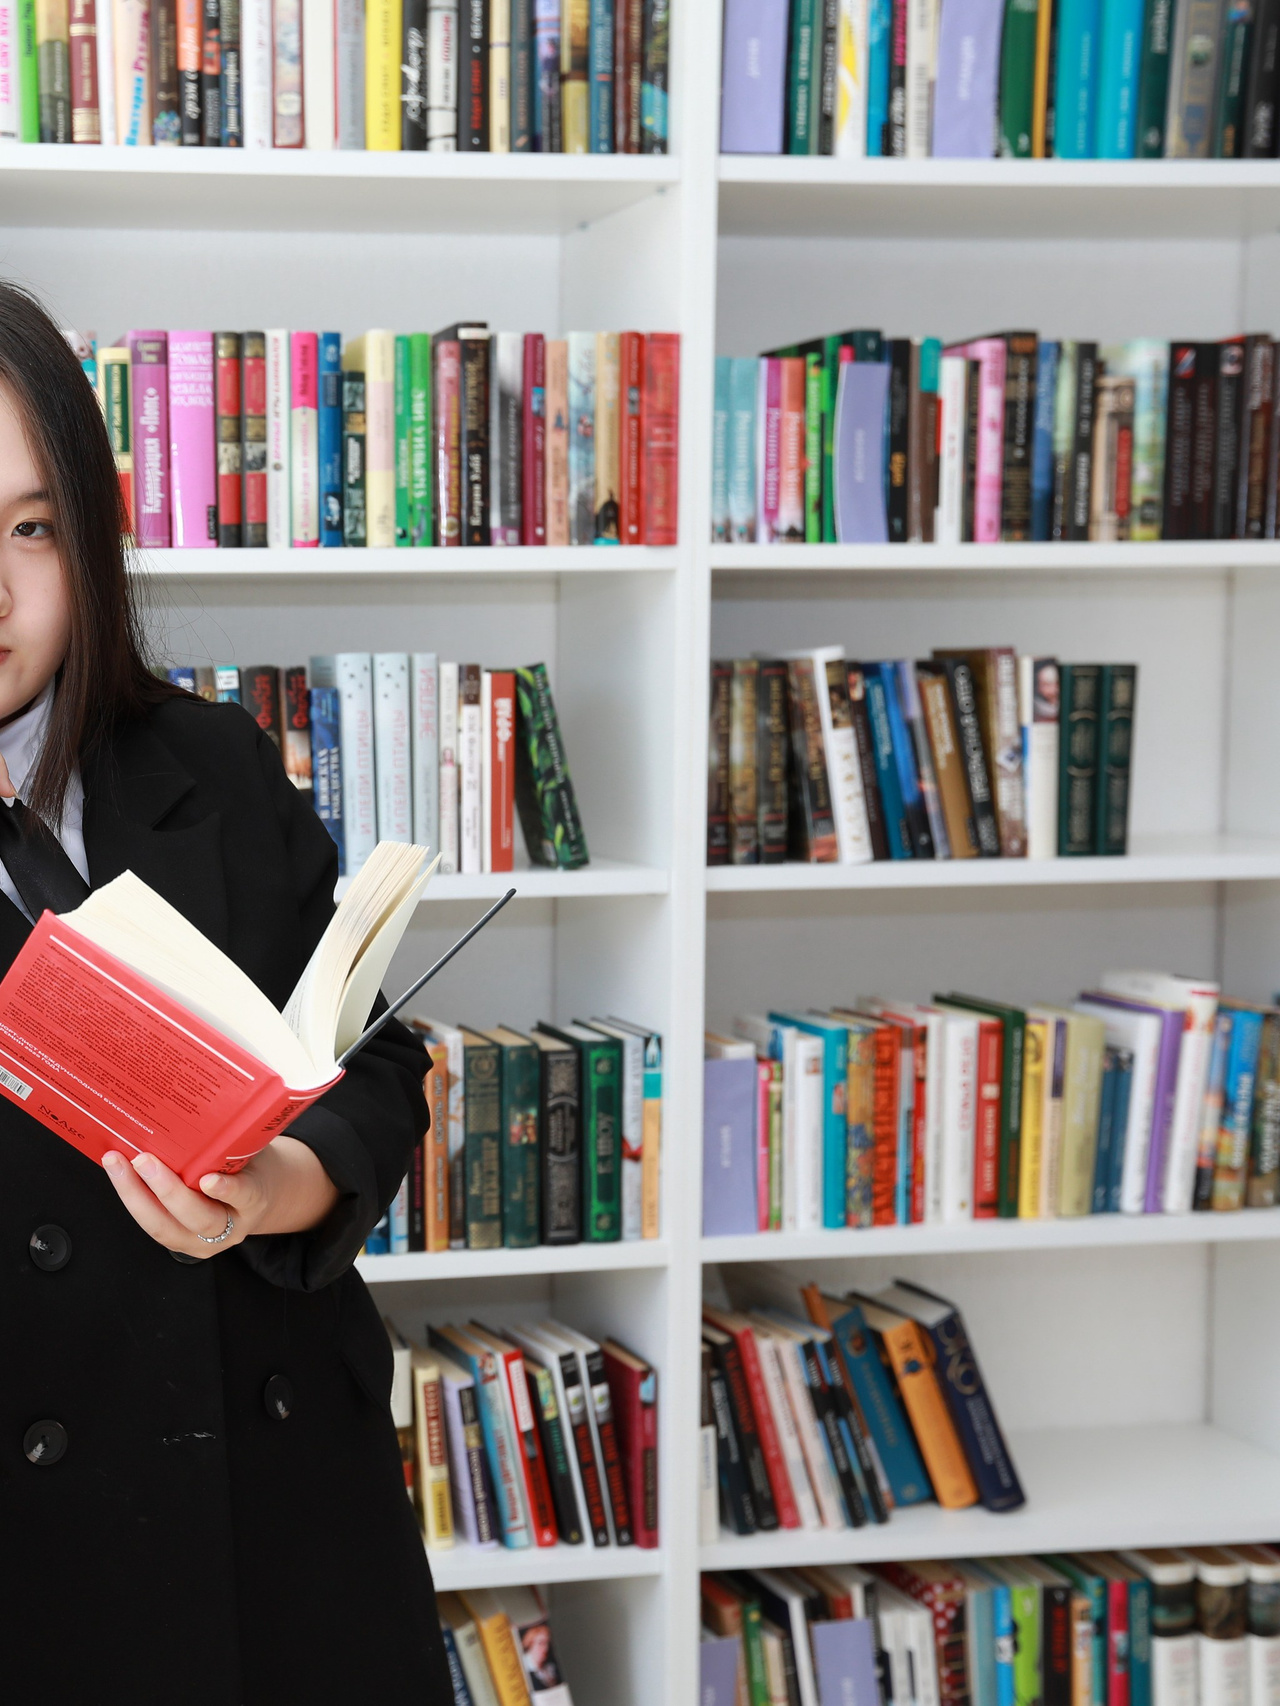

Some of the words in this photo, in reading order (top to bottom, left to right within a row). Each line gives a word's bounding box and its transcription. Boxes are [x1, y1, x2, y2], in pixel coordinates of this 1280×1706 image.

[23, 1044, 41, 1058] 2020
[40, 1056, 61, 1072] ГОДА
[37, 1049, 103, 1098] МЕЖДУНАРОДНОЙ
[102, 1096, 154, 1134] БУКЕРОВСКОЙ
